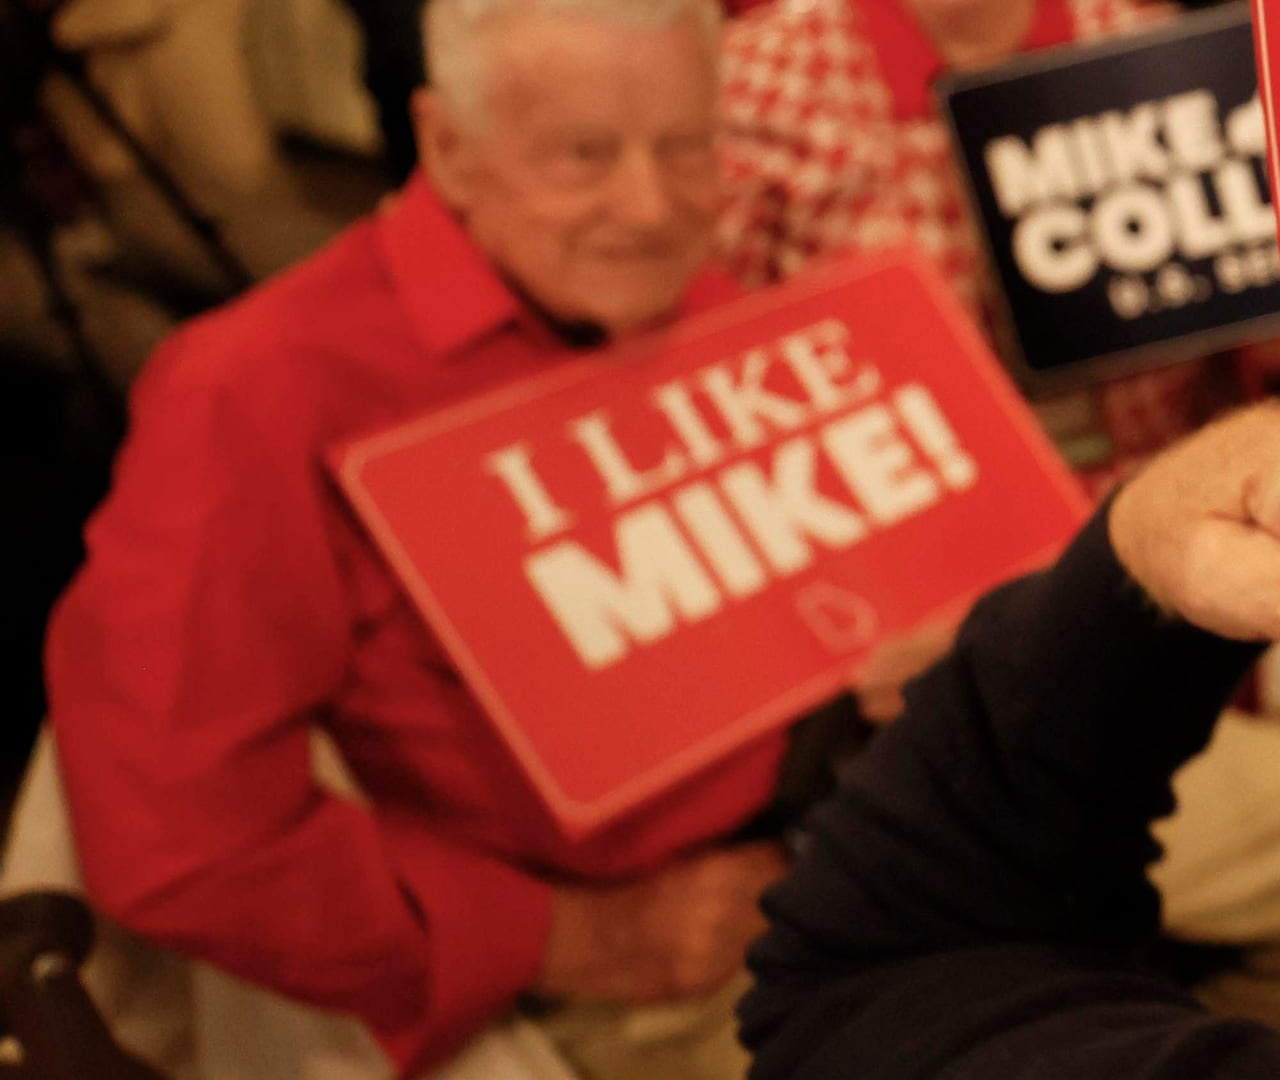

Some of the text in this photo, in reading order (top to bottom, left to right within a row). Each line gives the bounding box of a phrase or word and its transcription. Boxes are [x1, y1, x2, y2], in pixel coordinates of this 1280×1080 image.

[486, 318, 883, 539] I LIKE
[524, 384, 978, 670] MIKE!
